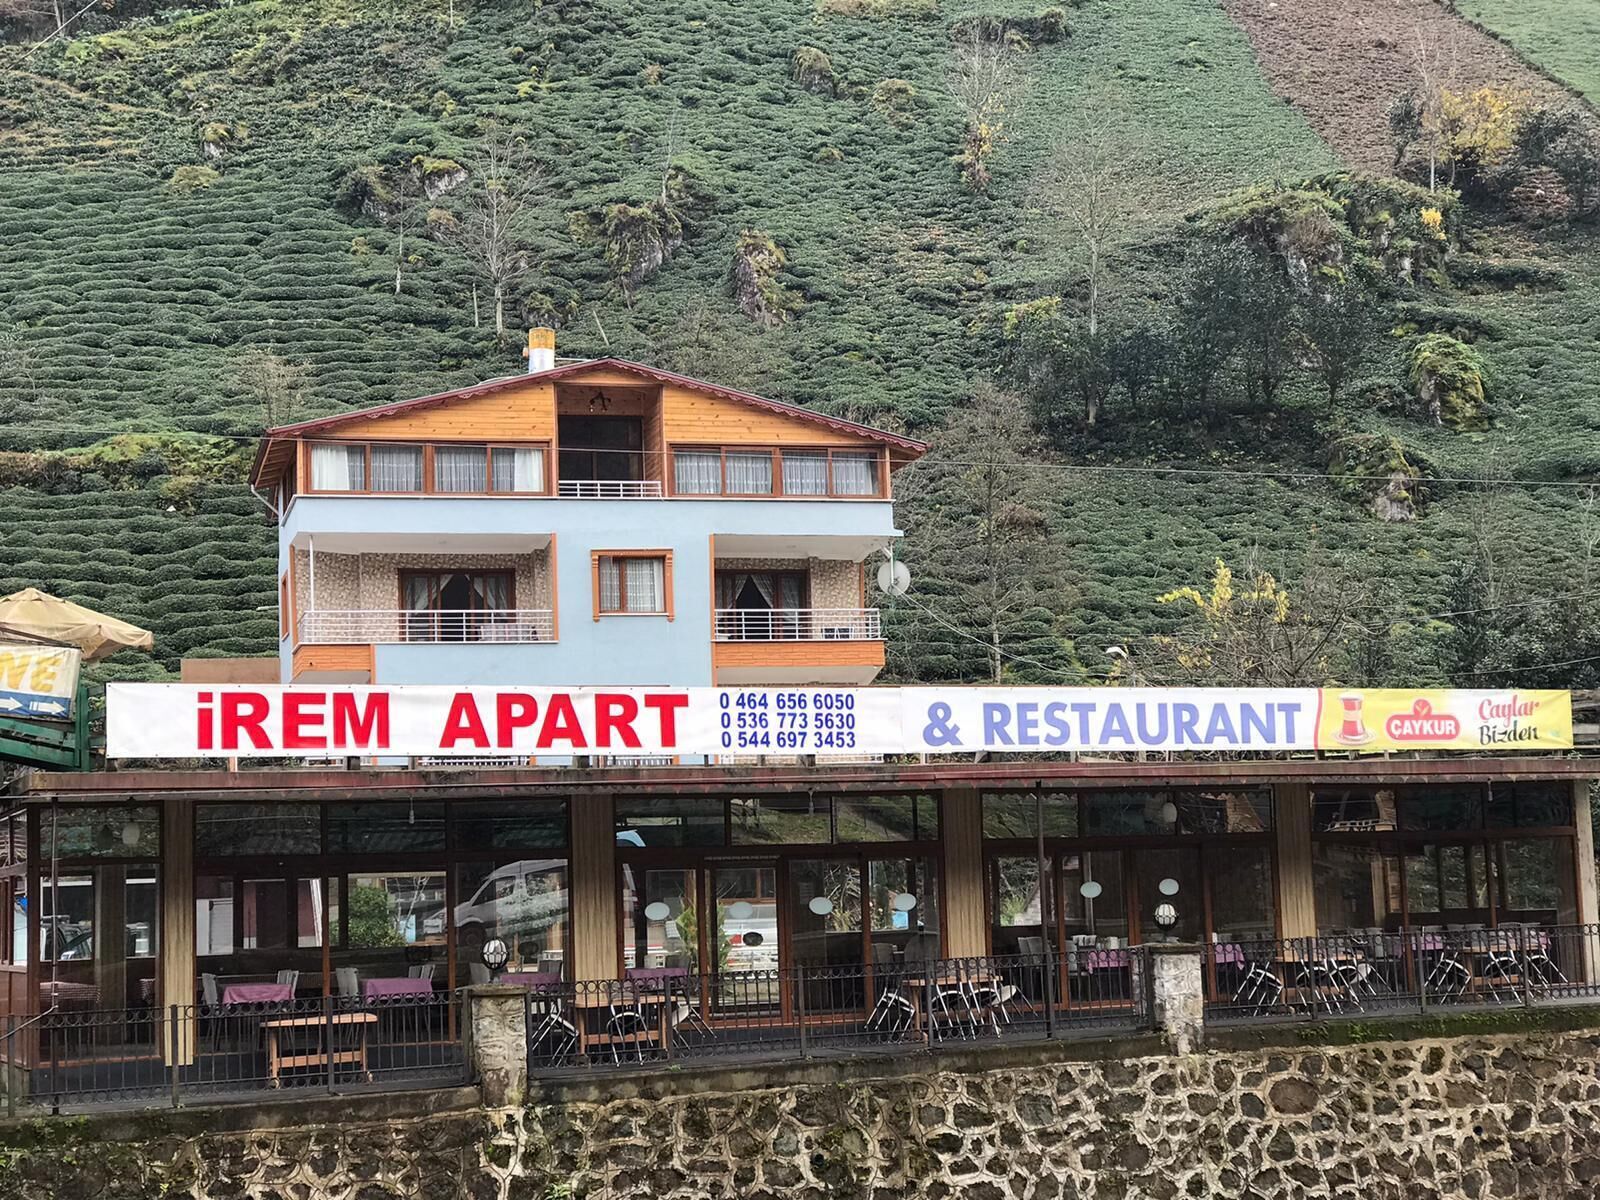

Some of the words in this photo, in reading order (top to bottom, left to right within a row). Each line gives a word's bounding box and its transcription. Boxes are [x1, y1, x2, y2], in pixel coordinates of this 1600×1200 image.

[720, 692, 730, 710] 0
[736, 692, 768, 710] 464
[776, 693, 807, 710] 656
[813, 693, 855, 711] 6050
[440, 693, 688, 749] APART
[721, 711, 731, 729] 0
[737, 712, 769, 729] 536
[777, 712, 808, 729] 773
[814, 713, 855, 730] 5630
[923, 702, 962, 746] &
[984, 703, 1302, 747] RESTAURANT
[1389, 719, 1457, 738] ÇAYKUR
[722, 731, 732, 748] 0
[738, 731, 771, 748] 544
[776, 731, 807, 748] 697
[814, 731, 856, 748] 3453
[1480, 720, 1540, 746] Bizden
